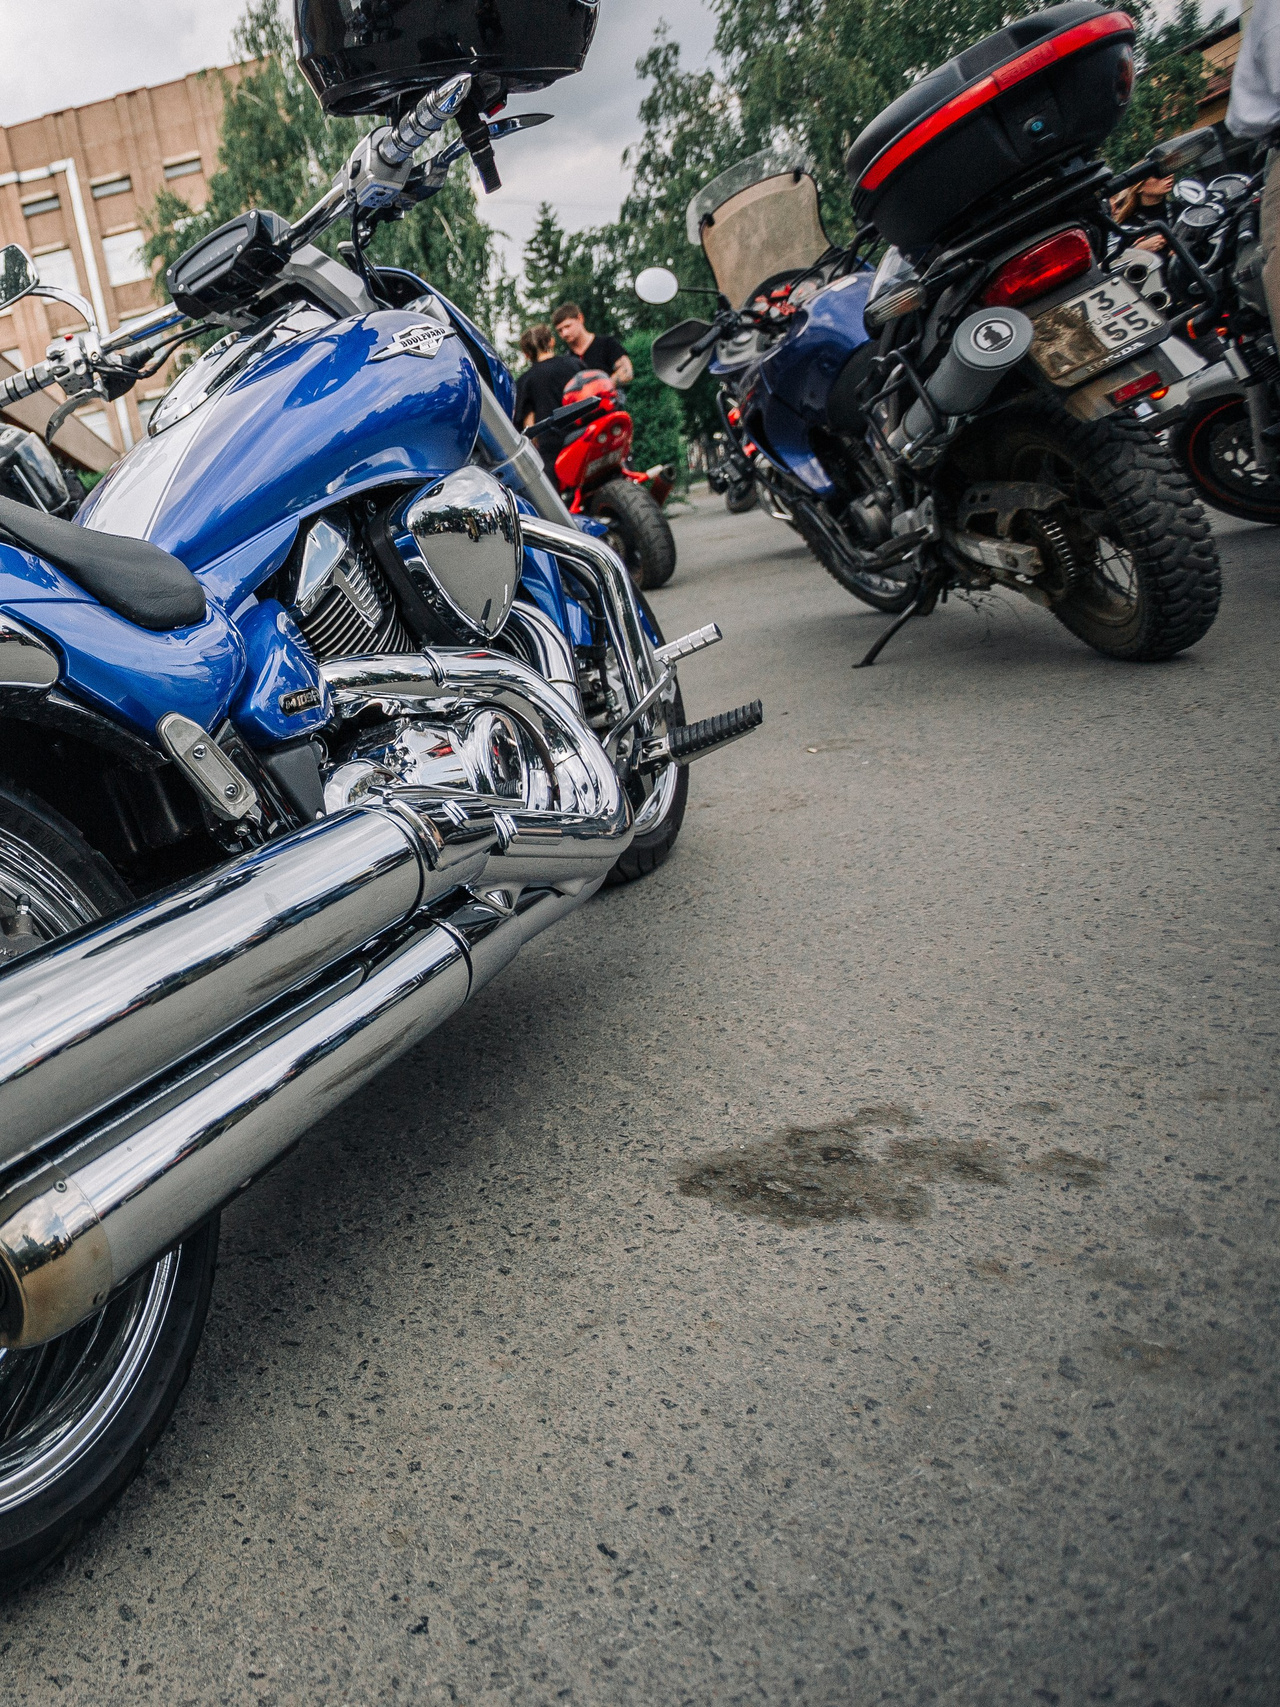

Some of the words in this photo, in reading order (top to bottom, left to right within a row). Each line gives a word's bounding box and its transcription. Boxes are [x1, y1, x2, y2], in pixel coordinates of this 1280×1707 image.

[400, 327, 446, 348] BOULEVARD
[1101, 310, 1149, 341] 55
[1085, 341, 1146, 372] HONDA
